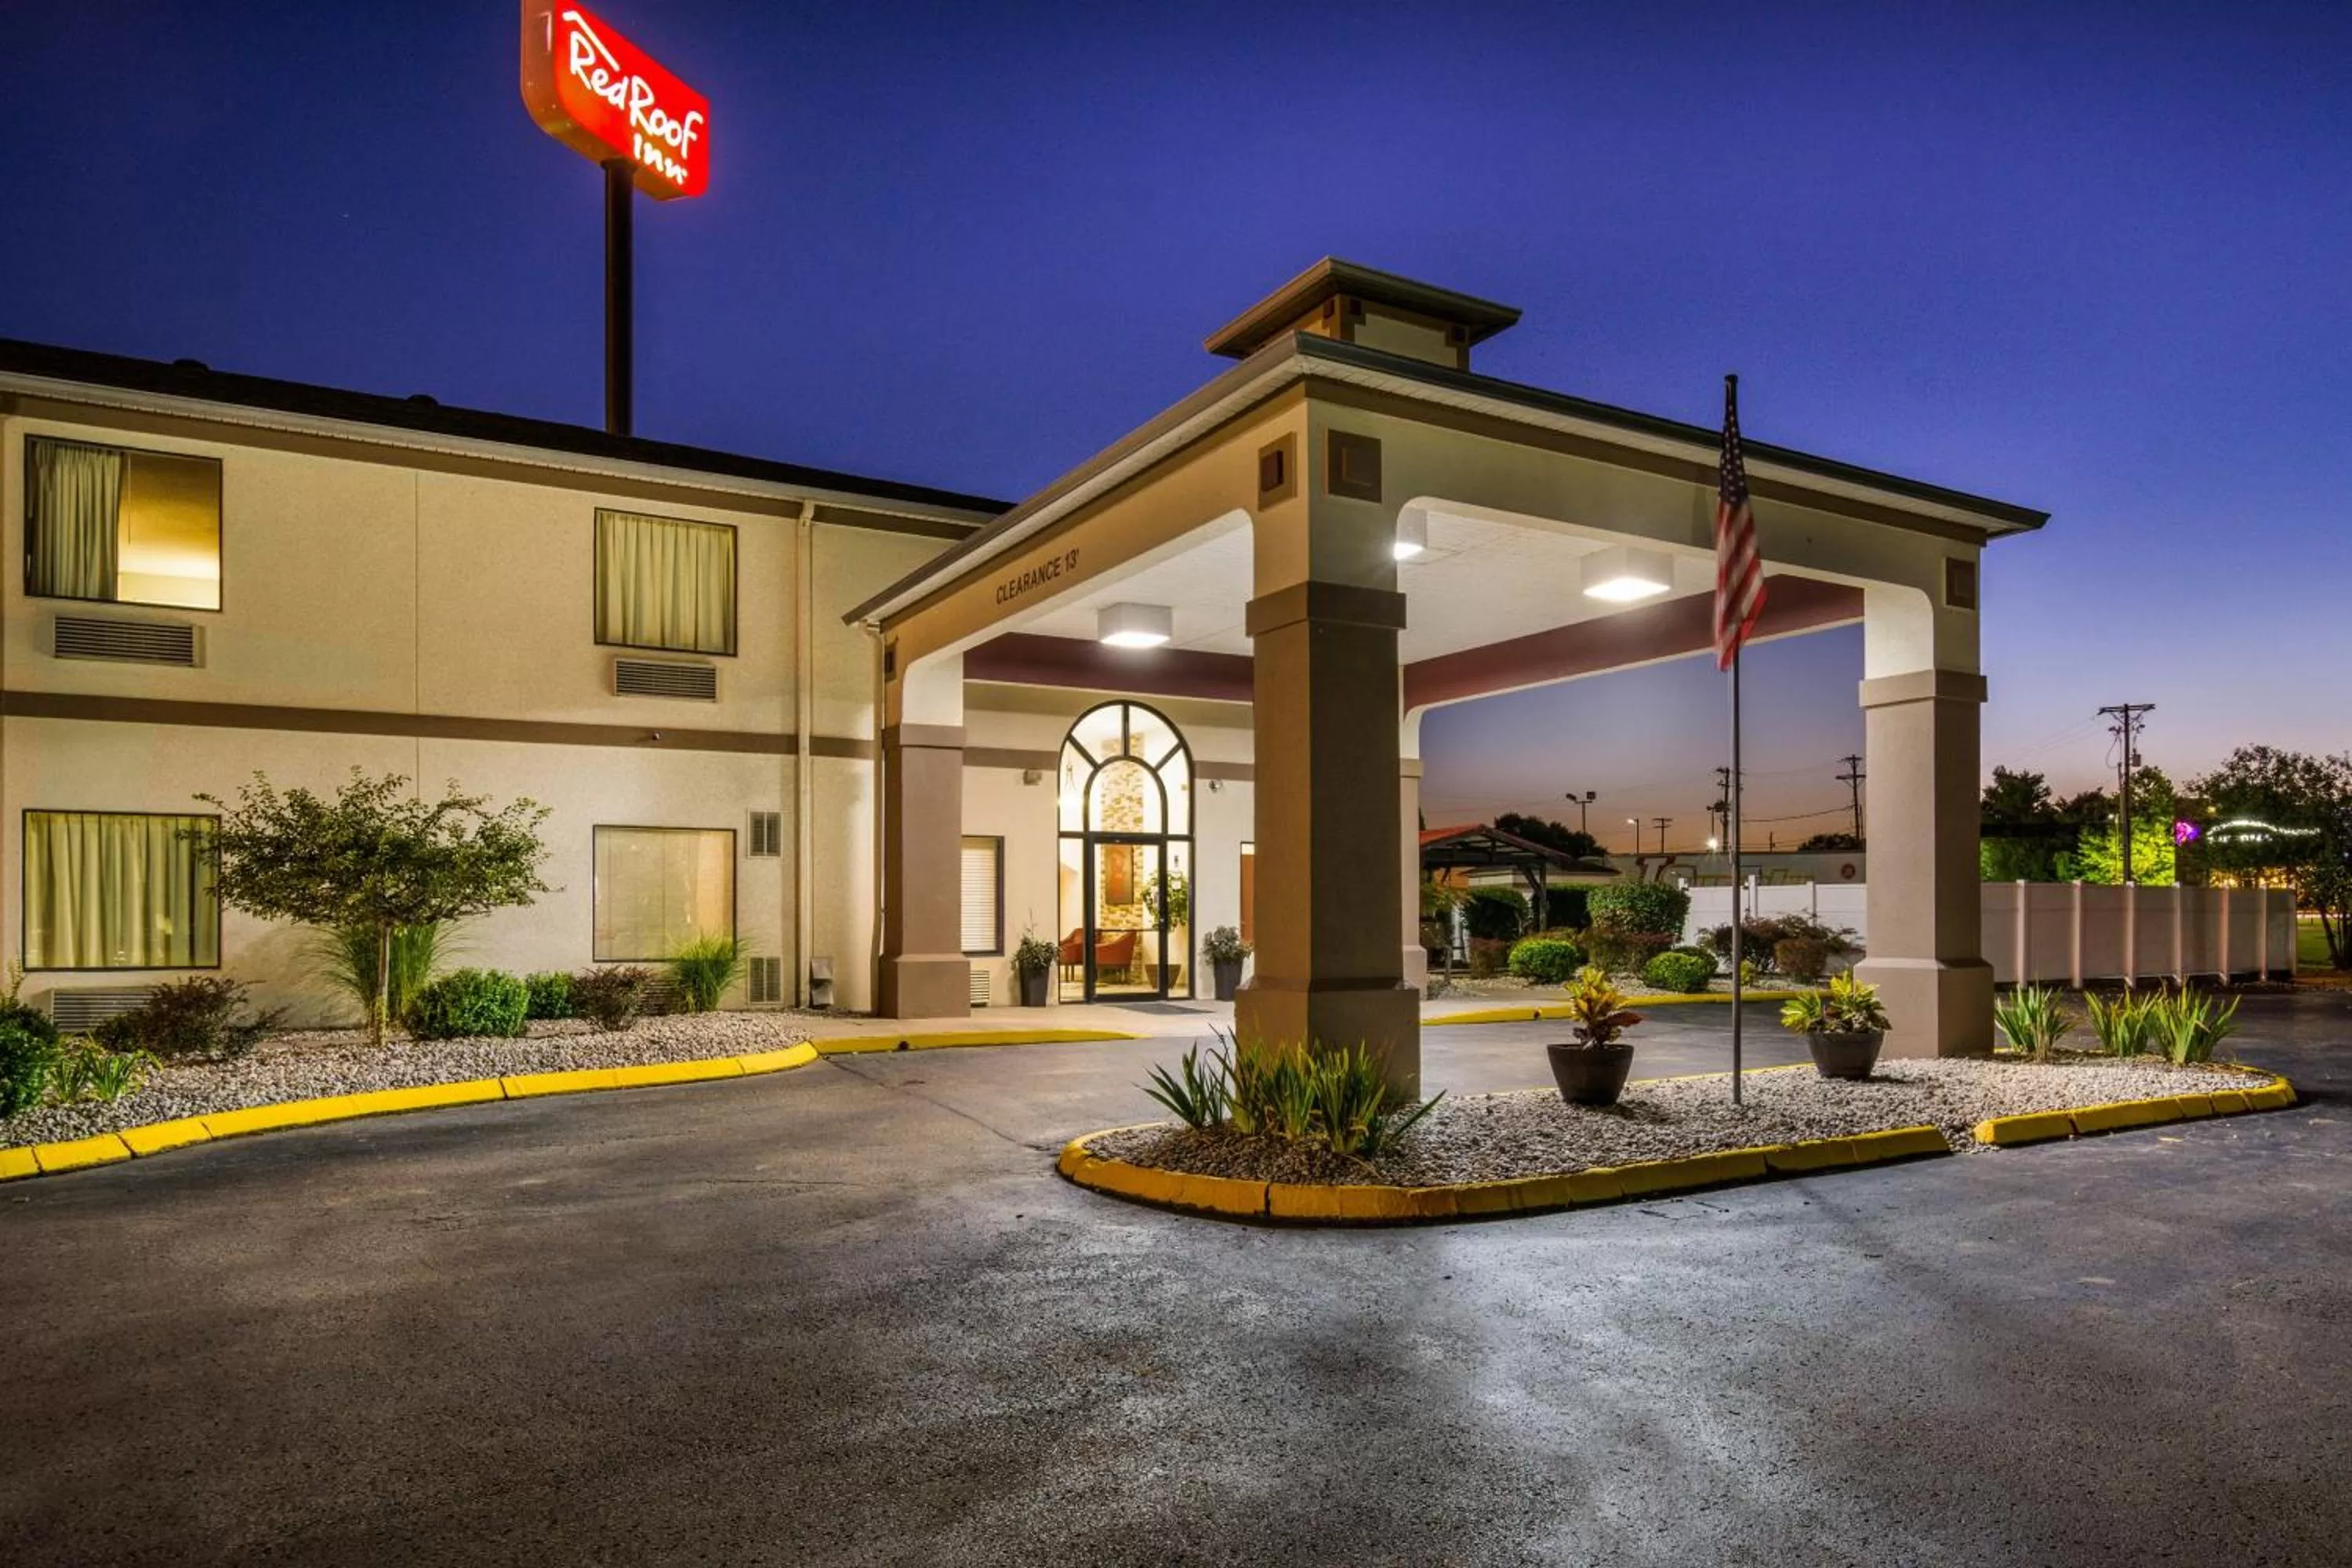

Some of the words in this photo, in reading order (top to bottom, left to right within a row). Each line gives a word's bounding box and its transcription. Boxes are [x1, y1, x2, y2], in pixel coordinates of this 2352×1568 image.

[570, 30, 630, 111] Red
[629, 74, 703, 159] Roof
[633, 132, 688, 185] Inn
[996, 556, 1061, 605] CLEARANCE
